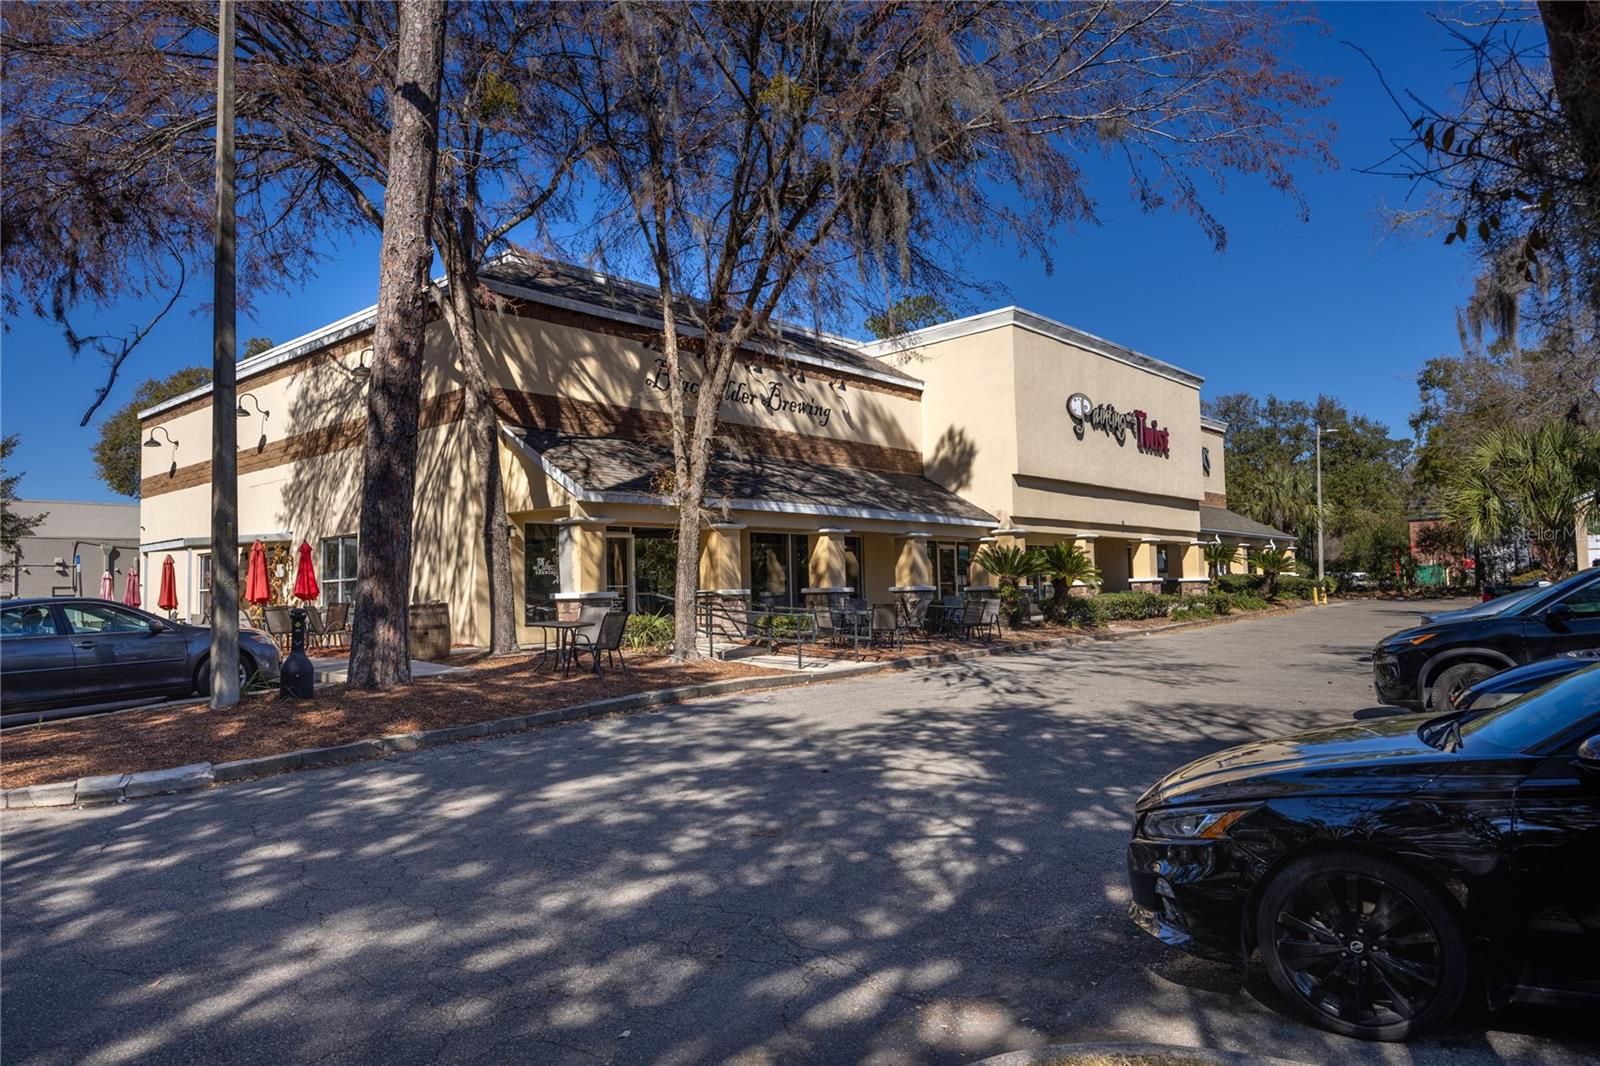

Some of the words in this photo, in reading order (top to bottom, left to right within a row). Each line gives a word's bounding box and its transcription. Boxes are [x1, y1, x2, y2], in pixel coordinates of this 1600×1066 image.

[762, 381, 832, 427] Brewing
[1066, 393, 1127, 444] Painting
[1134, 409, 1169, 454] Twist
